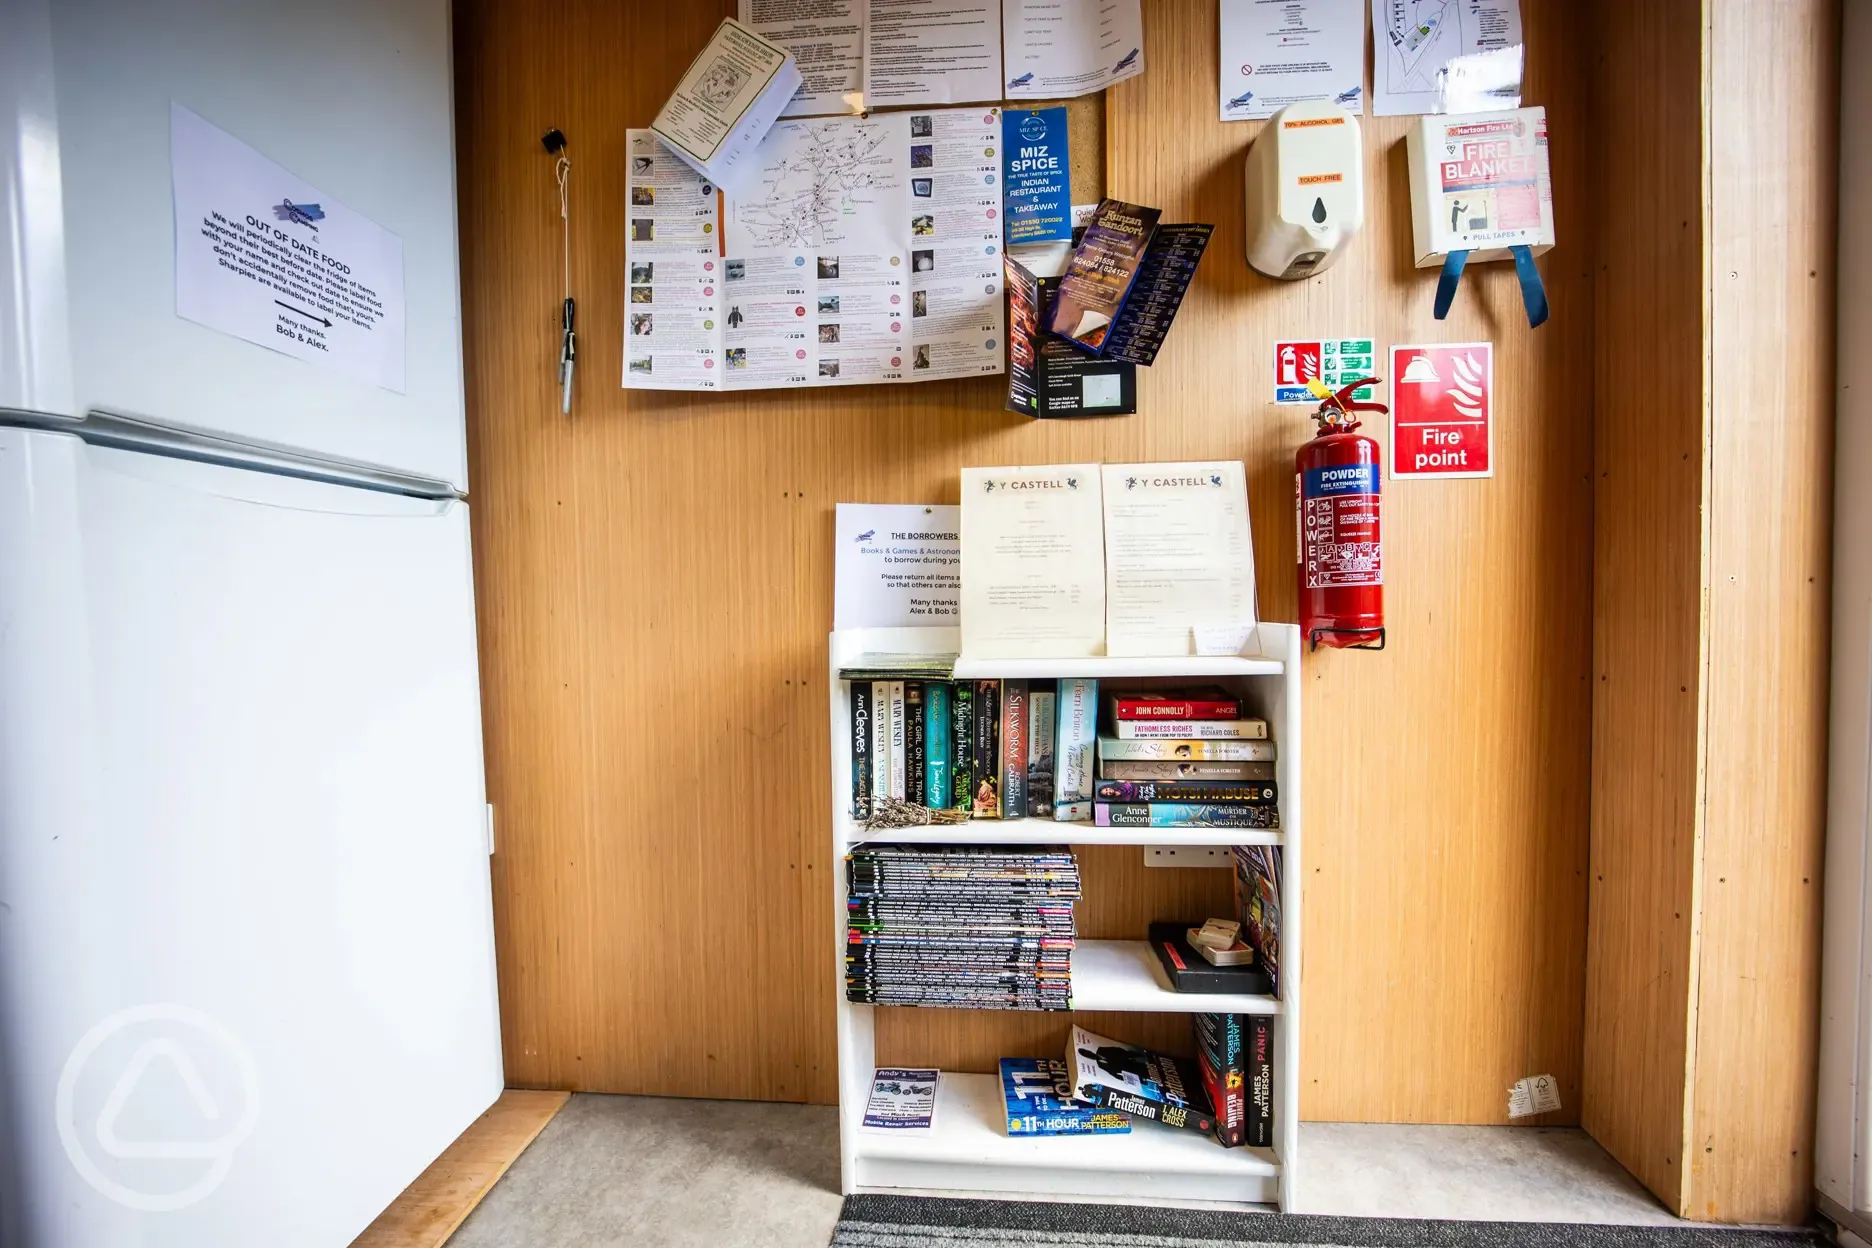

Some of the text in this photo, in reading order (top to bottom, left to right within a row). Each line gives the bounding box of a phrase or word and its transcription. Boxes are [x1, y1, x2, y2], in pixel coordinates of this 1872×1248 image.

[1458, 125, 1485, 135] Hartson
[1501, 123, 1513, 131] Ltd
[1020, 145, 1048, 158] MIZ
[1466, 141, 1509, 161] FIRE
[1011, 157, 1059, 172] SPICE
[1445, 158, 1532, 180] BLANKET
[1021, 178, 1049, 187] INDIAN
[1300, 176, 1321, 184] TOUCH
[1010, 185, 1061, 197] RESTAURANT
[1014, 202, 1058, 213] TAKEAWAY
[1473, 231, 1516, 241] PULL TAPES
[246, 215, 351, 275] OUT OF DATE FOOD
[212, 209, 376, 297] We will periodically clear the fridge of items
[204, 217, 383, 309] beyond their best before label food
[201, 228, 385, 318] with your name and check out date to ensure we
[213, 246, 237, 260] don't
[239, 257, 288, 285] accidentally
[290, 280, 317, 298] remove
[318, 294, 335, 305] food
[219, 257, 257, 280] Sharpies
[258, 276, 272, 287] are
[273, 282, 306, 303] available
[308, 299, 315, 307] to
[316, 301, 334, 314] label
[335, 310, 351, 323] your
[278, 313, 299, 331] Many
[276, 324, 330, 352] Bob & Alex.
[1422, 428, 1460, 446] Fire
[1415, 448, 1467, 469] point
[1141, 477, 1207, 487] Y CASTELL
[1321, 468, 1369, 482] POWDER
[1000, 480, 1063, 490] Y CASTELL
[891, 532, 958, 540] THE BORROWERS
[892, 547, 918, 555] Games
[922, 556, 947, 565] during
[932, 598, 958, 606] thanks
[1073, 685, 1085, 742] Fern Britton
[1136, 707, 1152, 715] JOHN
[1152, 707, 1184, 715] CONNOLLY
[856, 693, 867, 754] Ann Cleeves
[893, 699, 901, 748] MARY WESLEY
[1009, 695, 1022, 758] SILKWORM
[1134, 725, 1171, 733] FATHOMLESS
[956, 701, 967, 767] Midnight House
[915, 747, 922, 760] ON
[914, 779, 922, 805] TRAIN
[1203, 787, 1259, 799] MABUSE
[1126, 806, 1148, 815] Anne
[1112, 813, 1162, 823] Glenconner
[1257, 1026, 1266, 1062] PANIC
[1253, 1075, 1262, 1106] JAMES
[1261, 1064, 1269, 1117] PATTERSON
[1107, 1092, 1156, 1119] Patterson
[1130, 1095, 1145, 1105] James
[1090, 1114, 1120, 1122] JAMES
[1168, 1106, 1188, 1119] ALEX
[1227, 1094, 1237, 1129] BEIJING
[1046, 1118, 1079, 1129] HOUR
[1081, 1120, 1129, 1130] PATTERSON
[1162, 1113, 1185, 1128] CROSS
